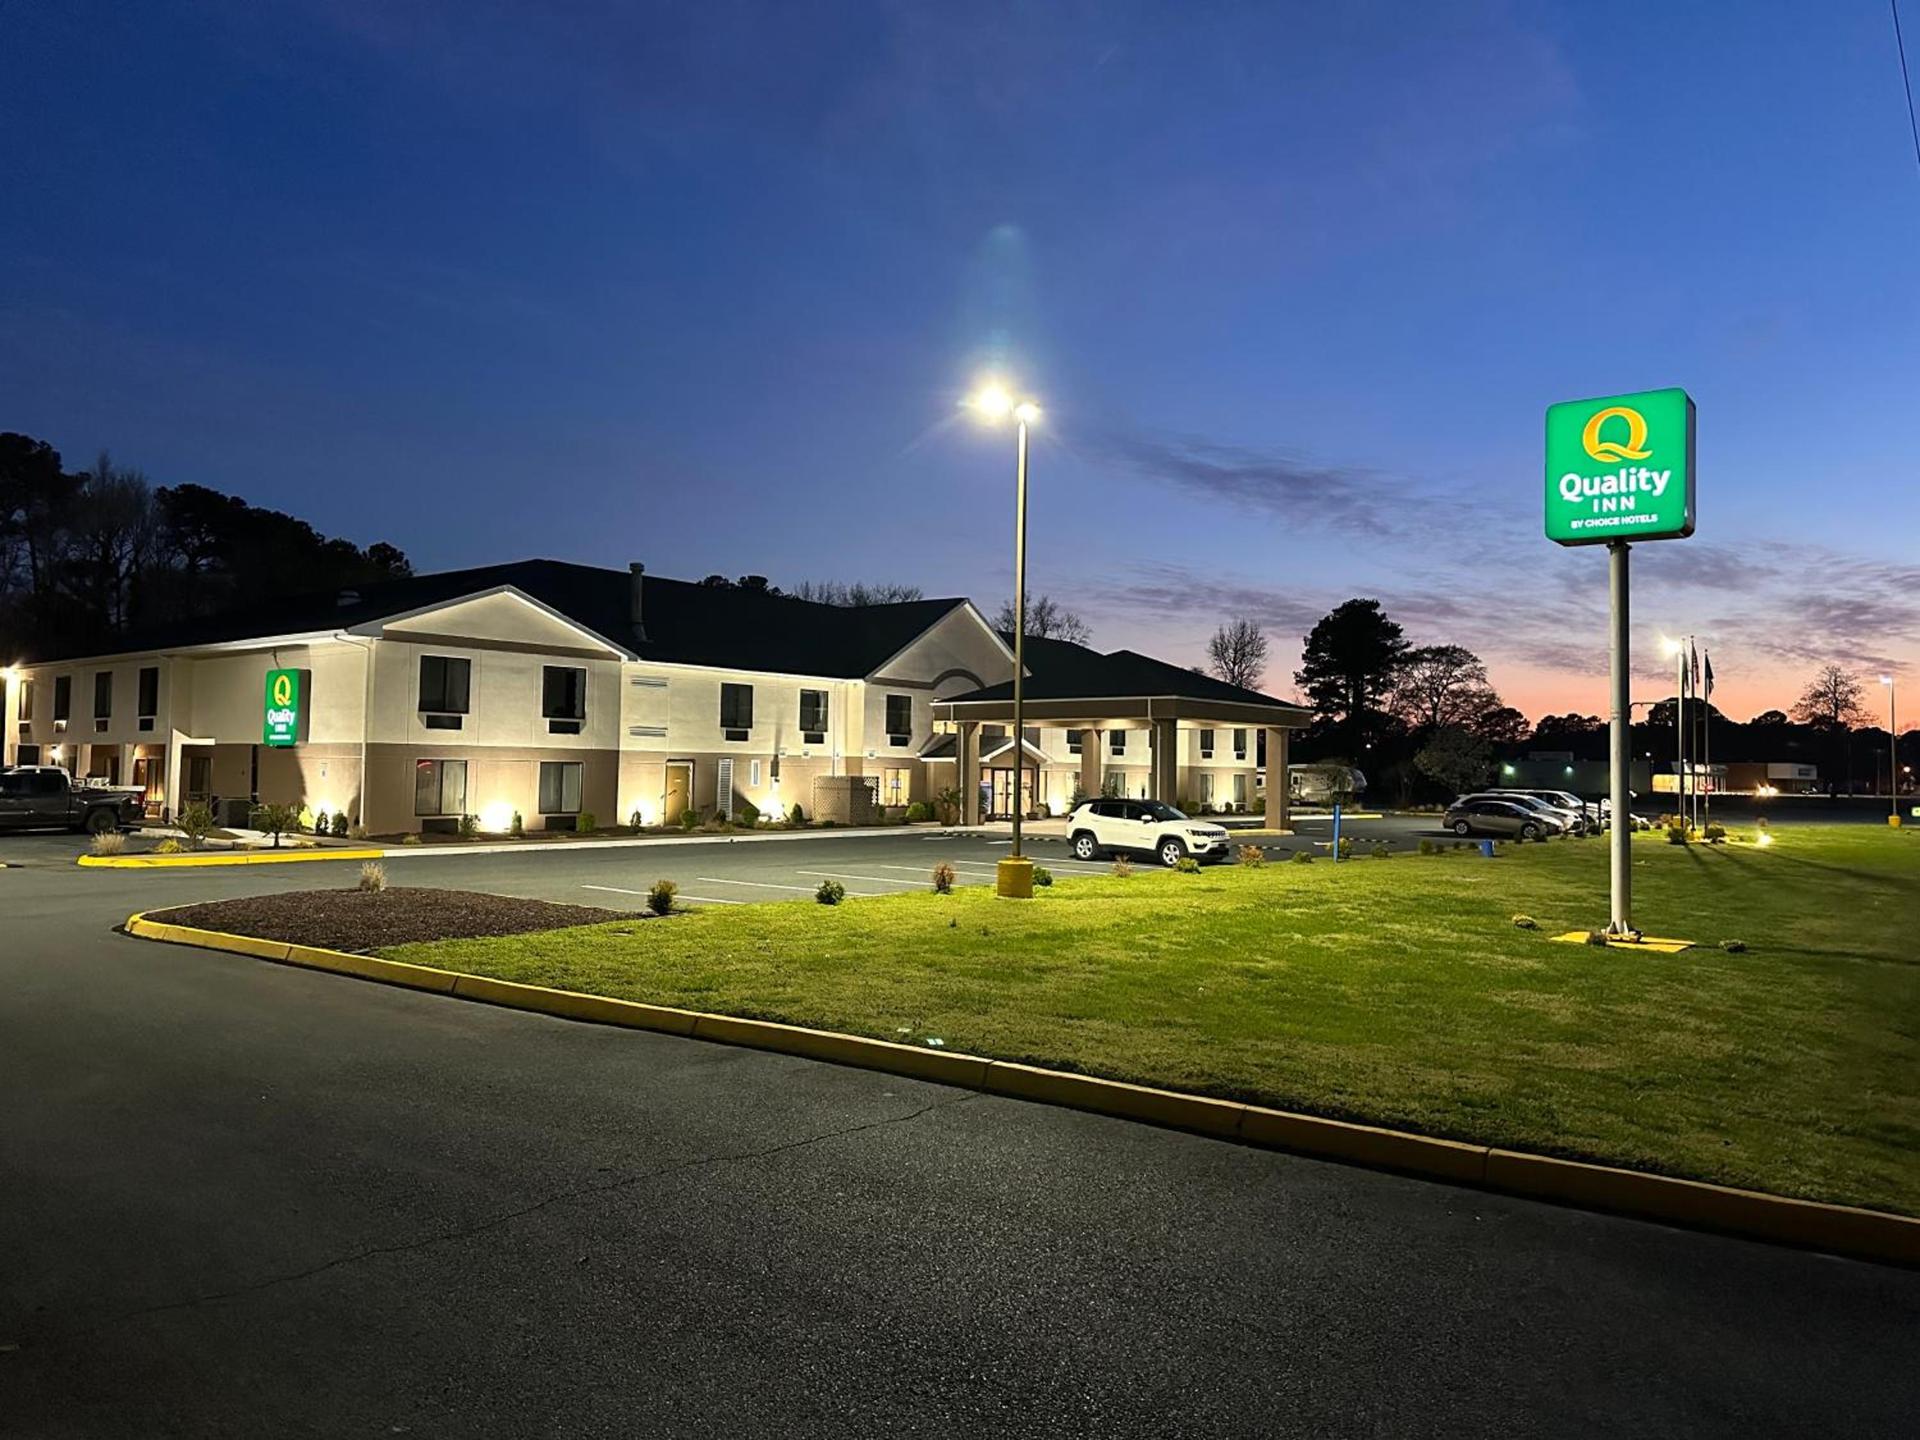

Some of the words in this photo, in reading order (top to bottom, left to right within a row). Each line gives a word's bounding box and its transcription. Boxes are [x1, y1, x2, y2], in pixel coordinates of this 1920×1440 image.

[1583, 407, 1653, 463] Q
[1559, 467, 1671, 502] Quality
[1593, 495, 1635, 513] INN
[1571, 519, 1584, 529] BY
[1585, 516, 1620, 528] CHOICE
[1621, 514, 1658, 525] HOTELS
[274, 675, 291, 706] Q
